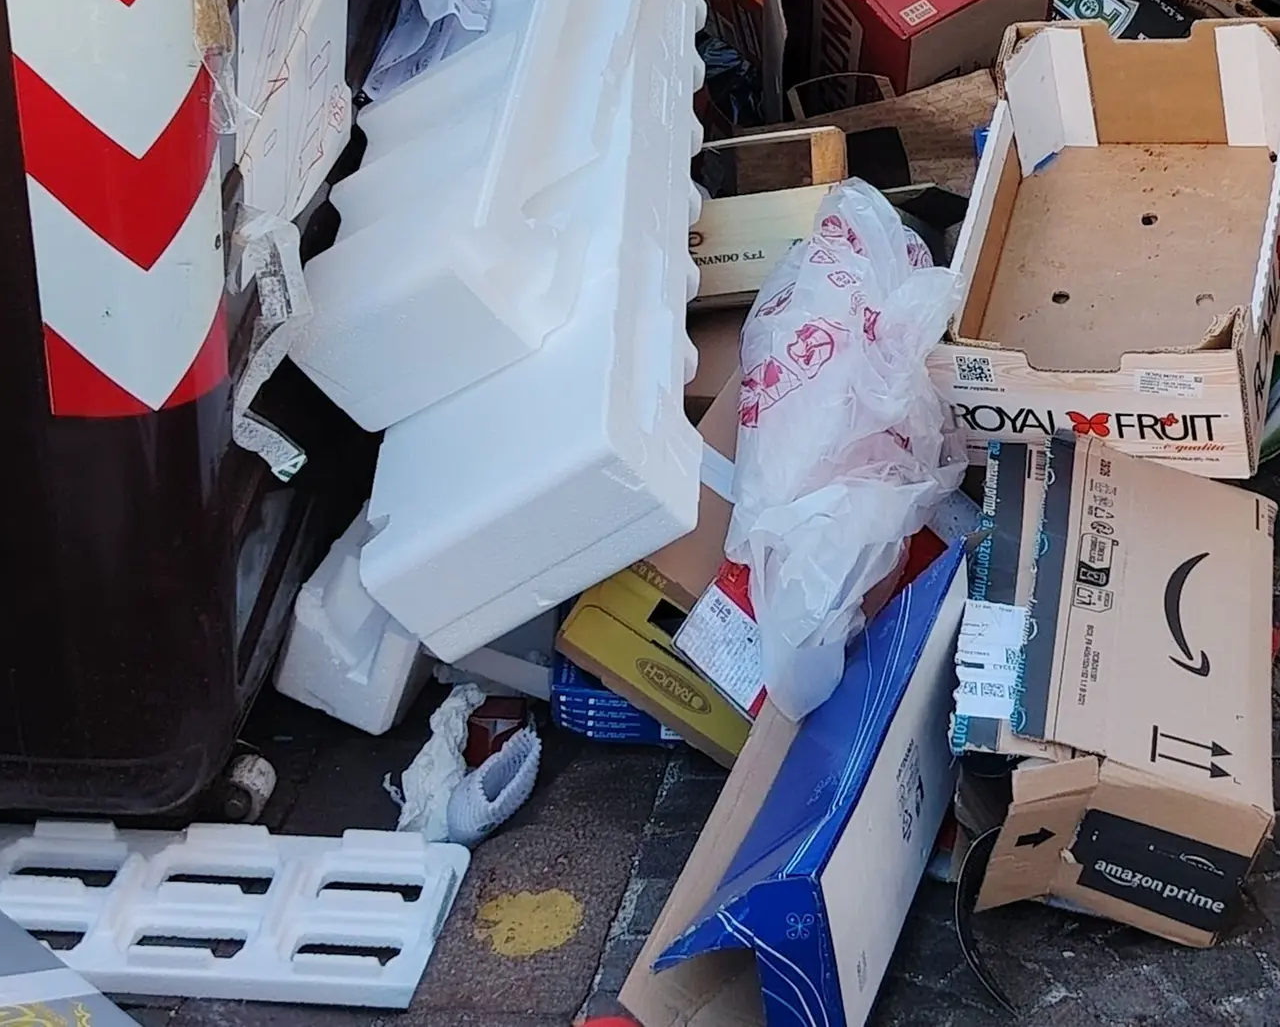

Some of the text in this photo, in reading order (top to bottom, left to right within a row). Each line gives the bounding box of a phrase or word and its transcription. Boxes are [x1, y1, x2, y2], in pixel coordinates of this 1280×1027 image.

[693, 253, 740, 266] NANDO
[1115, 411, 1223, 443] FRUIT
[643, 662, 694, 703] RAUCH
[1094, 859, 1226, 914] amazon prime
